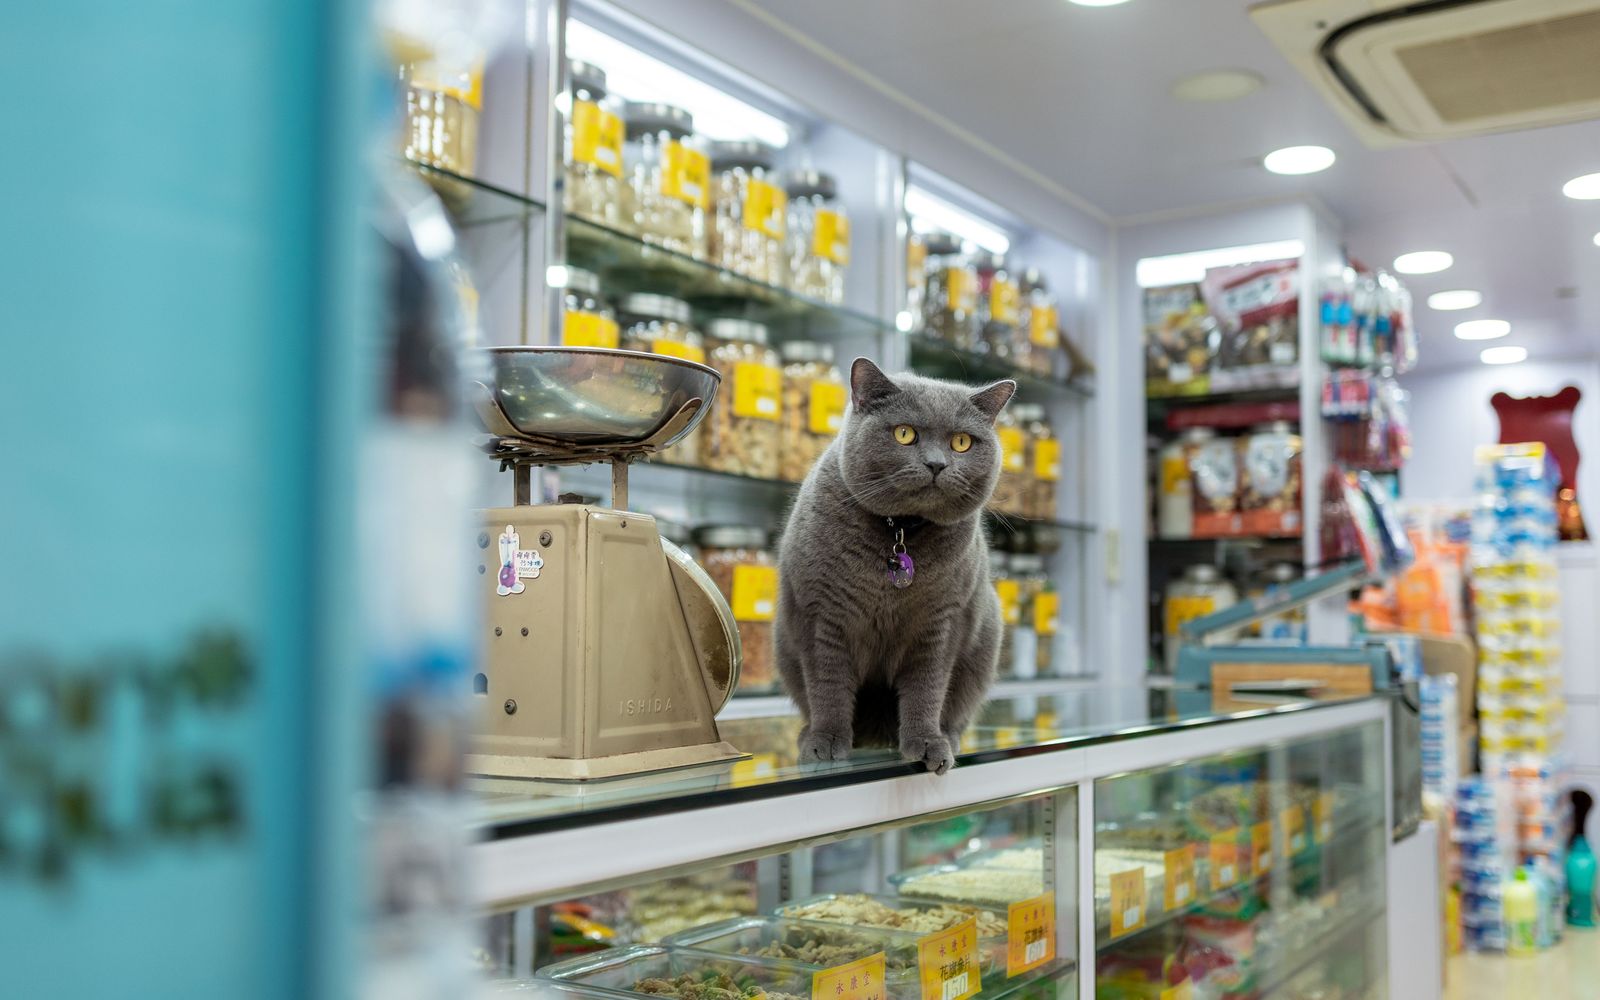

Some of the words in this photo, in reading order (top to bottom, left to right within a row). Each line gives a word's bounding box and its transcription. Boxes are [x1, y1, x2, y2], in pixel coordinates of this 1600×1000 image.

[619, 697, 672, 715] ISHIDA
[939, 934, 968, 958] 永康堂
[834, 969, 872, 996] 永康堂
